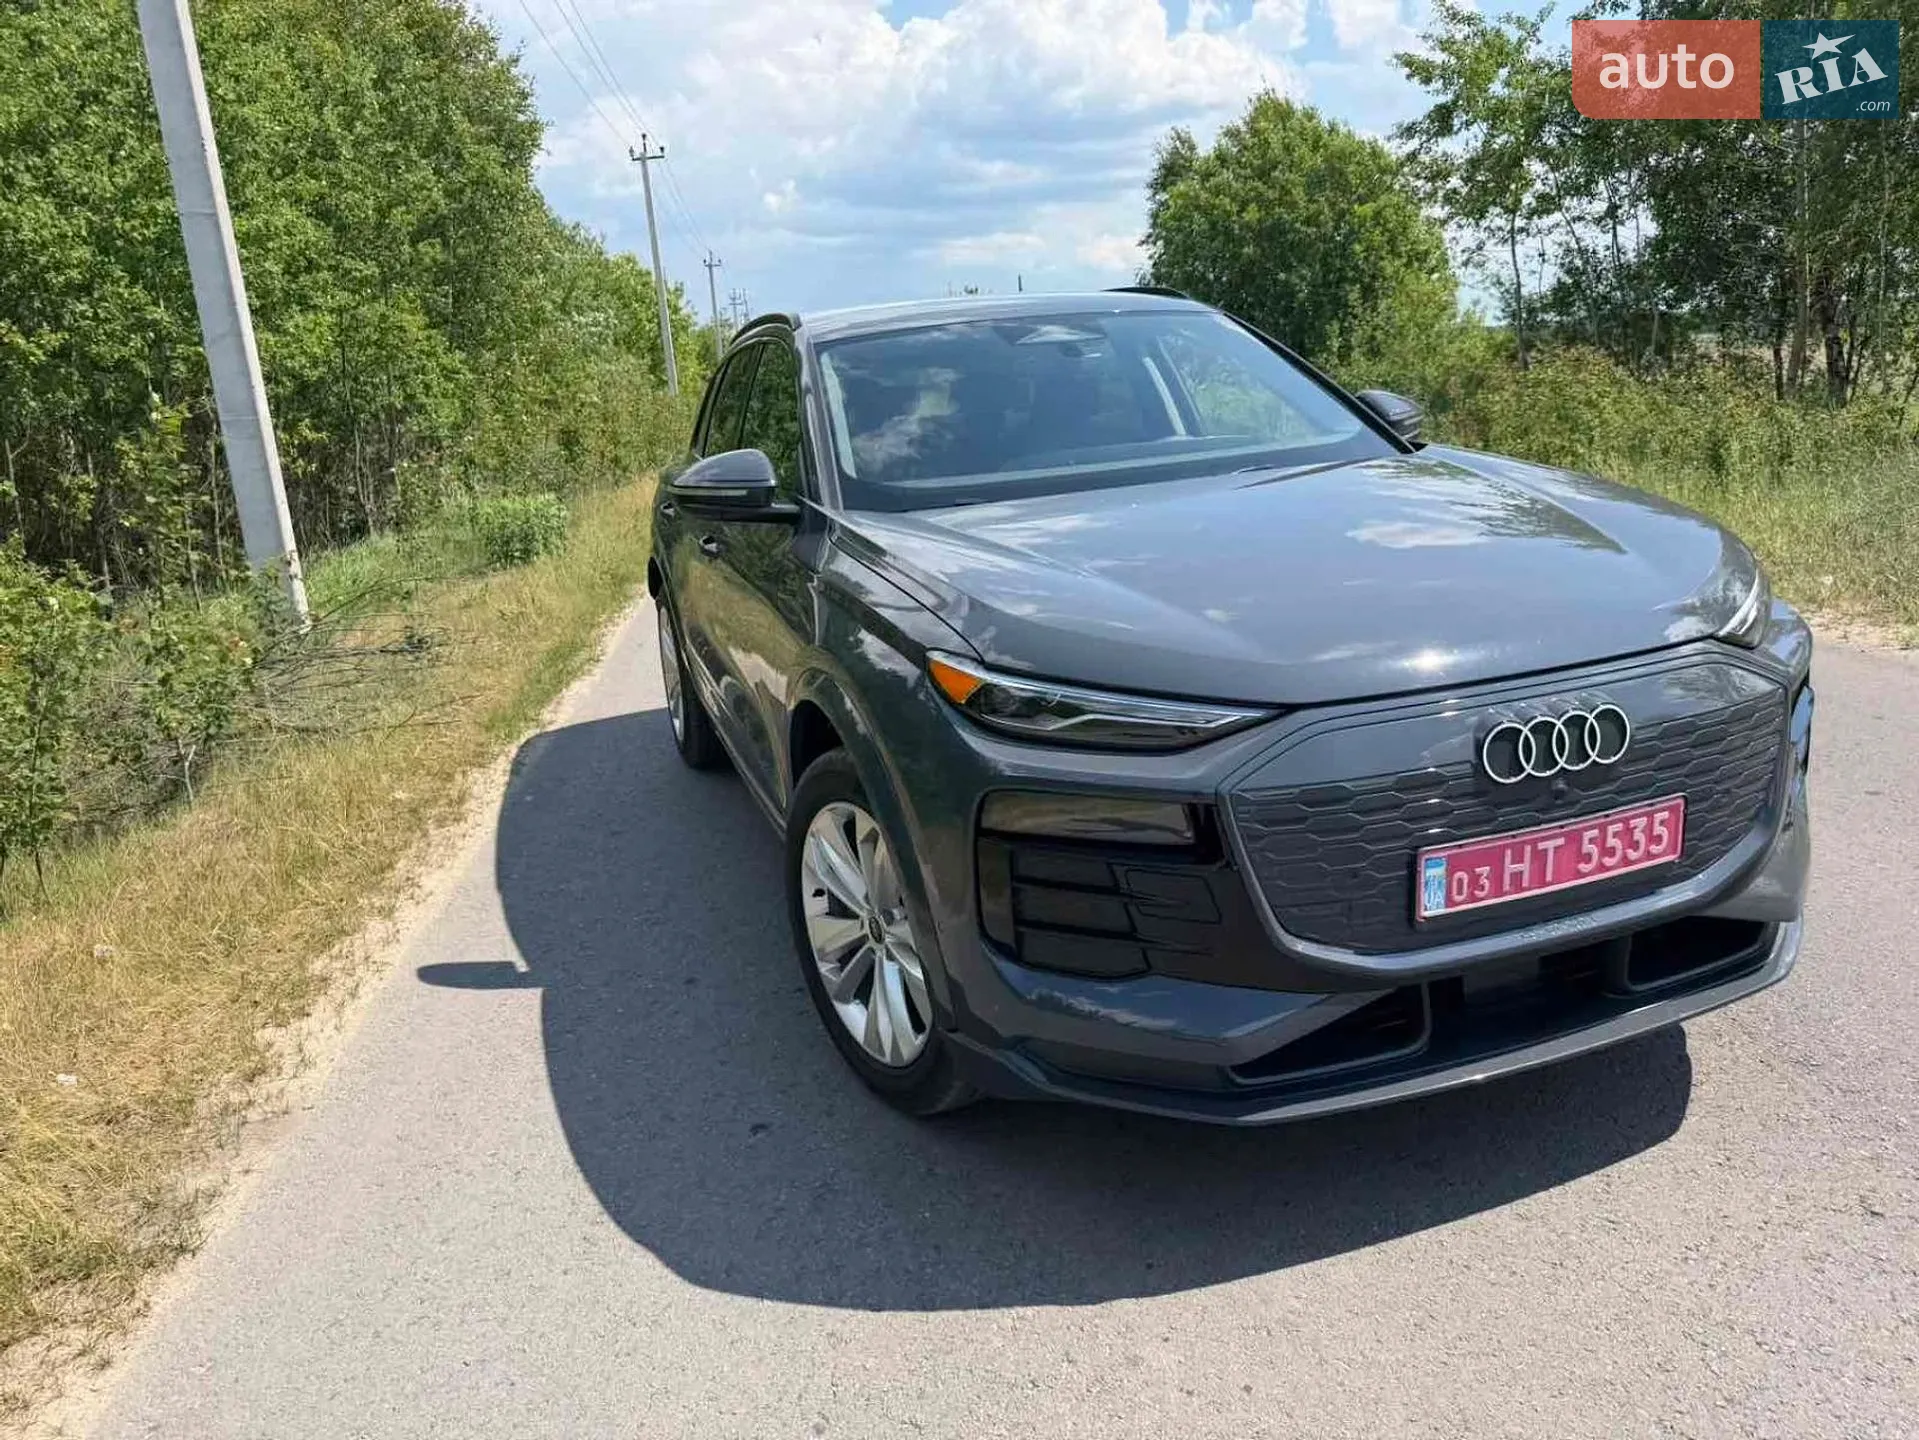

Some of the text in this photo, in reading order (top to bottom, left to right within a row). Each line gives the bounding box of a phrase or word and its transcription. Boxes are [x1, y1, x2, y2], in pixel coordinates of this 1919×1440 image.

[1452, 811, 1669, 901] 03 HT 5535
